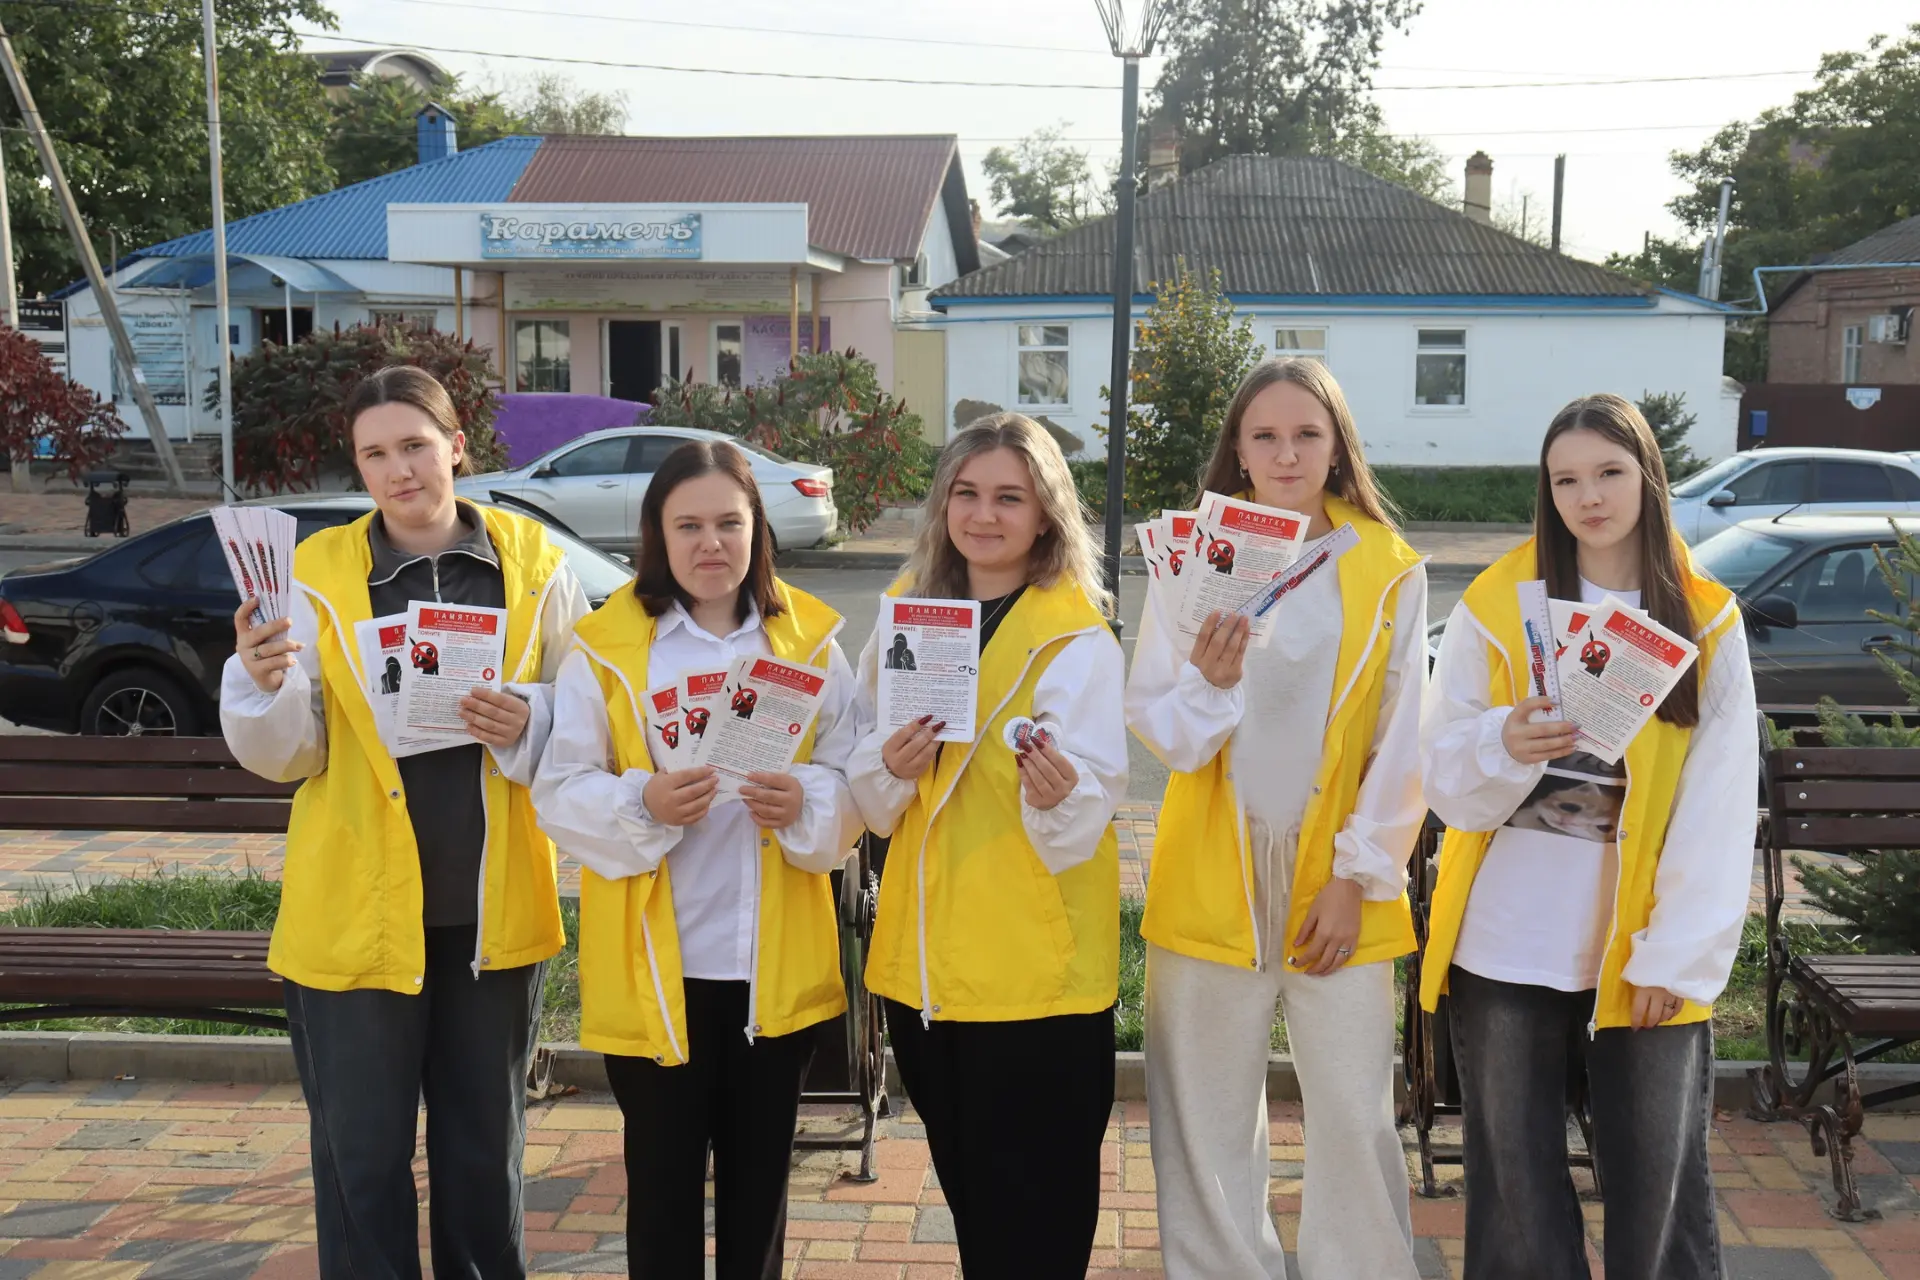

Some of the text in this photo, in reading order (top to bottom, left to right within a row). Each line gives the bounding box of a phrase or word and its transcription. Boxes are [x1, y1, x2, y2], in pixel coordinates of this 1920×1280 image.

[487, 217, 694, 245] Карамель
[134, 321, 173, 329] АДВОКАТ
[1237, 511, 1286, 527] ПАМЯТКА
[434, 611, 484, 622] ПАМЯТКА
[908, 606, 959, 616] ПАМЯТКА
[1624, 620, 1672, 651] ПАМЯТКА
[766, 664, 810, 683] ПАМЯТКА
